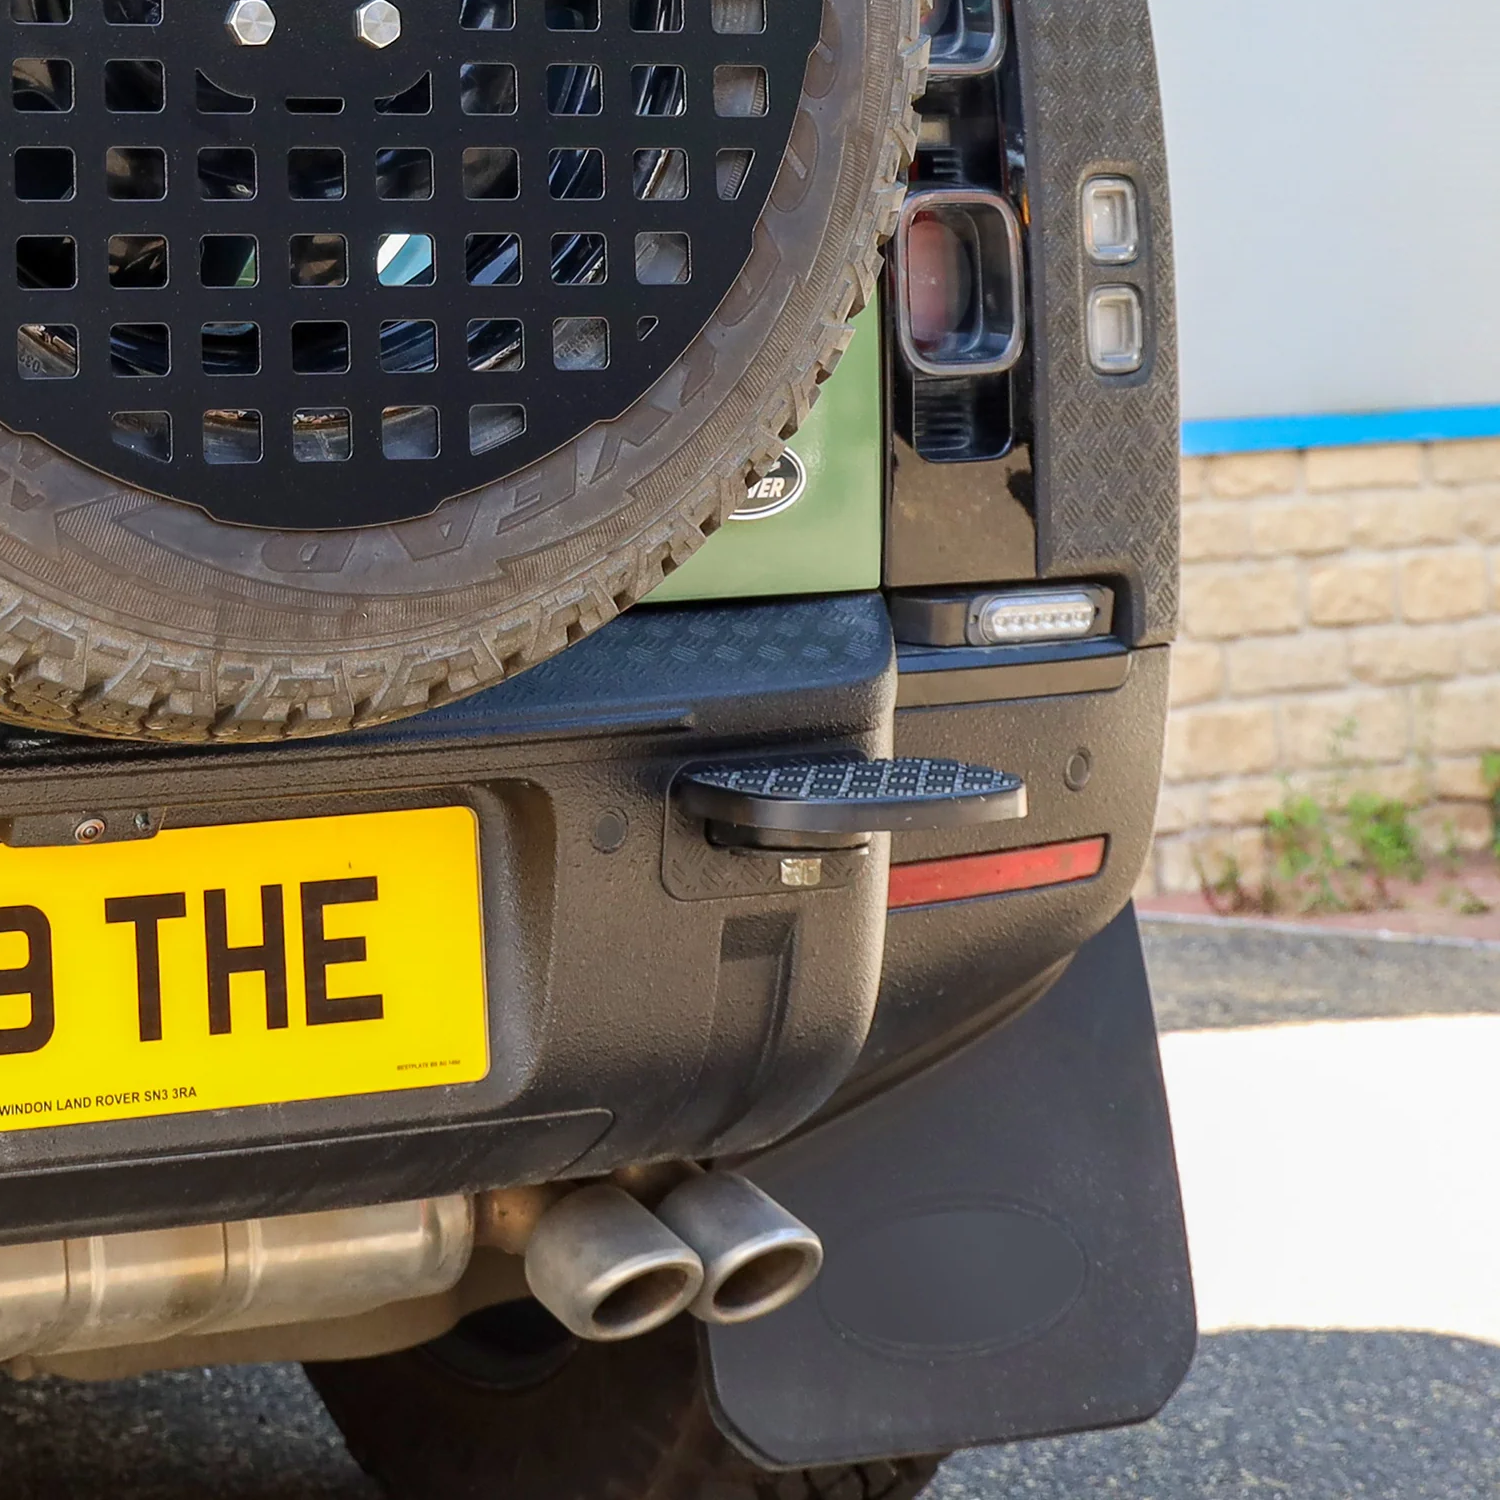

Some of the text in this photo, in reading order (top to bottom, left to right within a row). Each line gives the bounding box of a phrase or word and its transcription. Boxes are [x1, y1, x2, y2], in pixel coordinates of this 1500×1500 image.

[747, 477, 786, 499] VER
[104, 875, 384, 1042] THE
[56, 1096, 91, 1112] LAND
[96, 1091, 140, 1107] ROVER
[144, 1088, 169, 1102] SN3
[172, 1086, 197, 1099] 3RA
